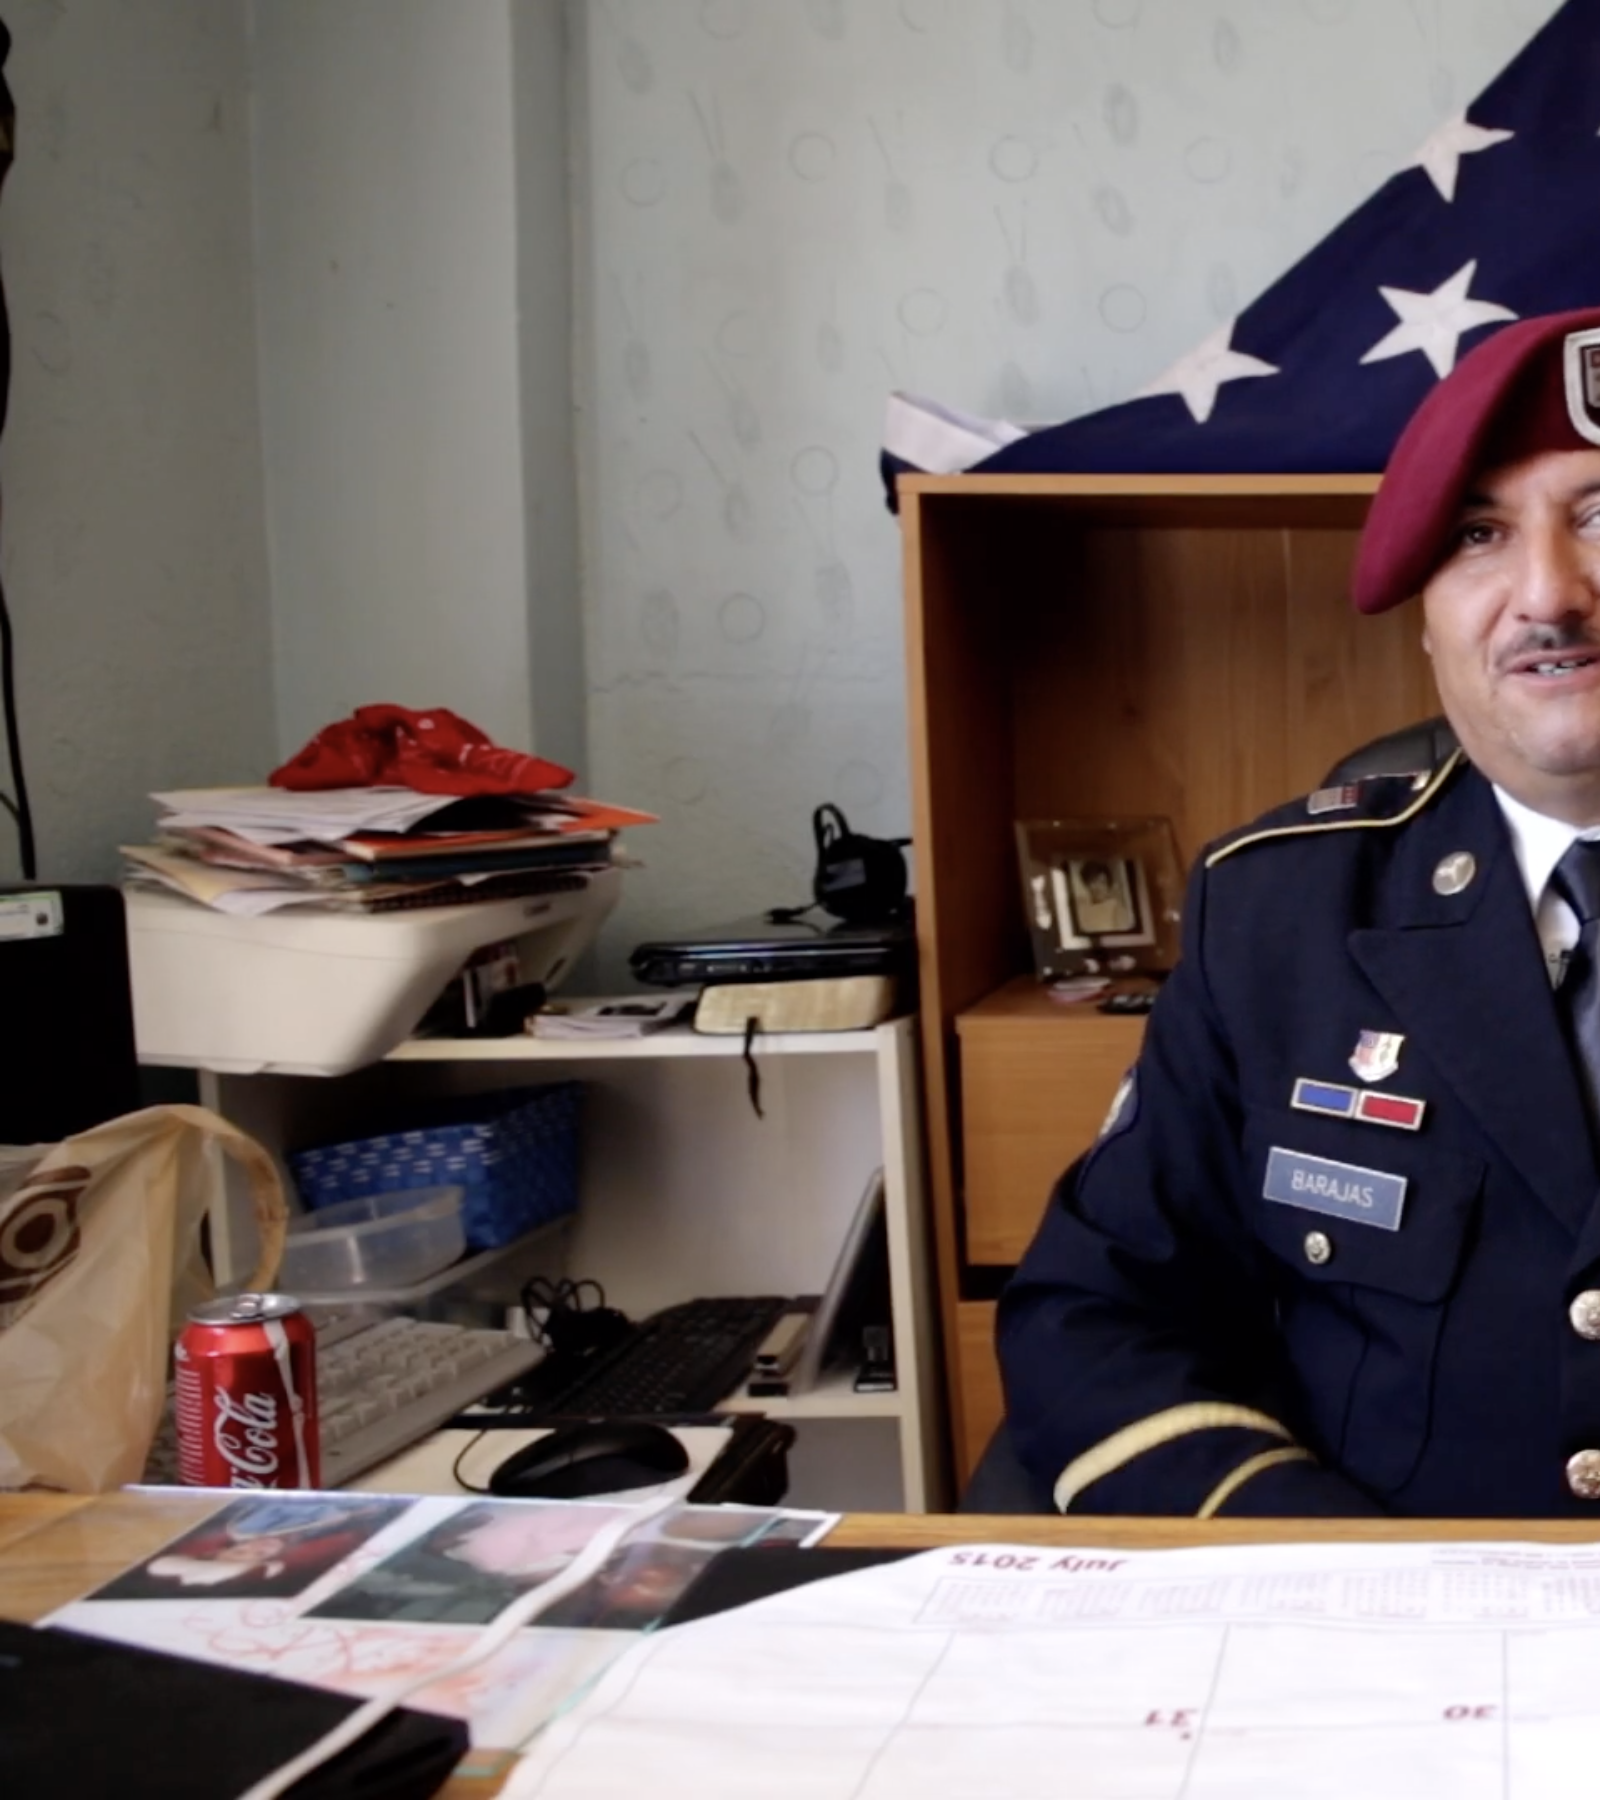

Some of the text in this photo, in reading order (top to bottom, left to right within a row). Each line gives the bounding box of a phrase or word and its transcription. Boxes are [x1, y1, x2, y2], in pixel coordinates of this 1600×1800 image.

[1291, 1169, 1373, 1208] BARAJAS
[948, 1552, 1128, 1573] July 2015
[1145, 1708, 1198, 1728] 31
[1443, 1704, 1498, 1721] 30
